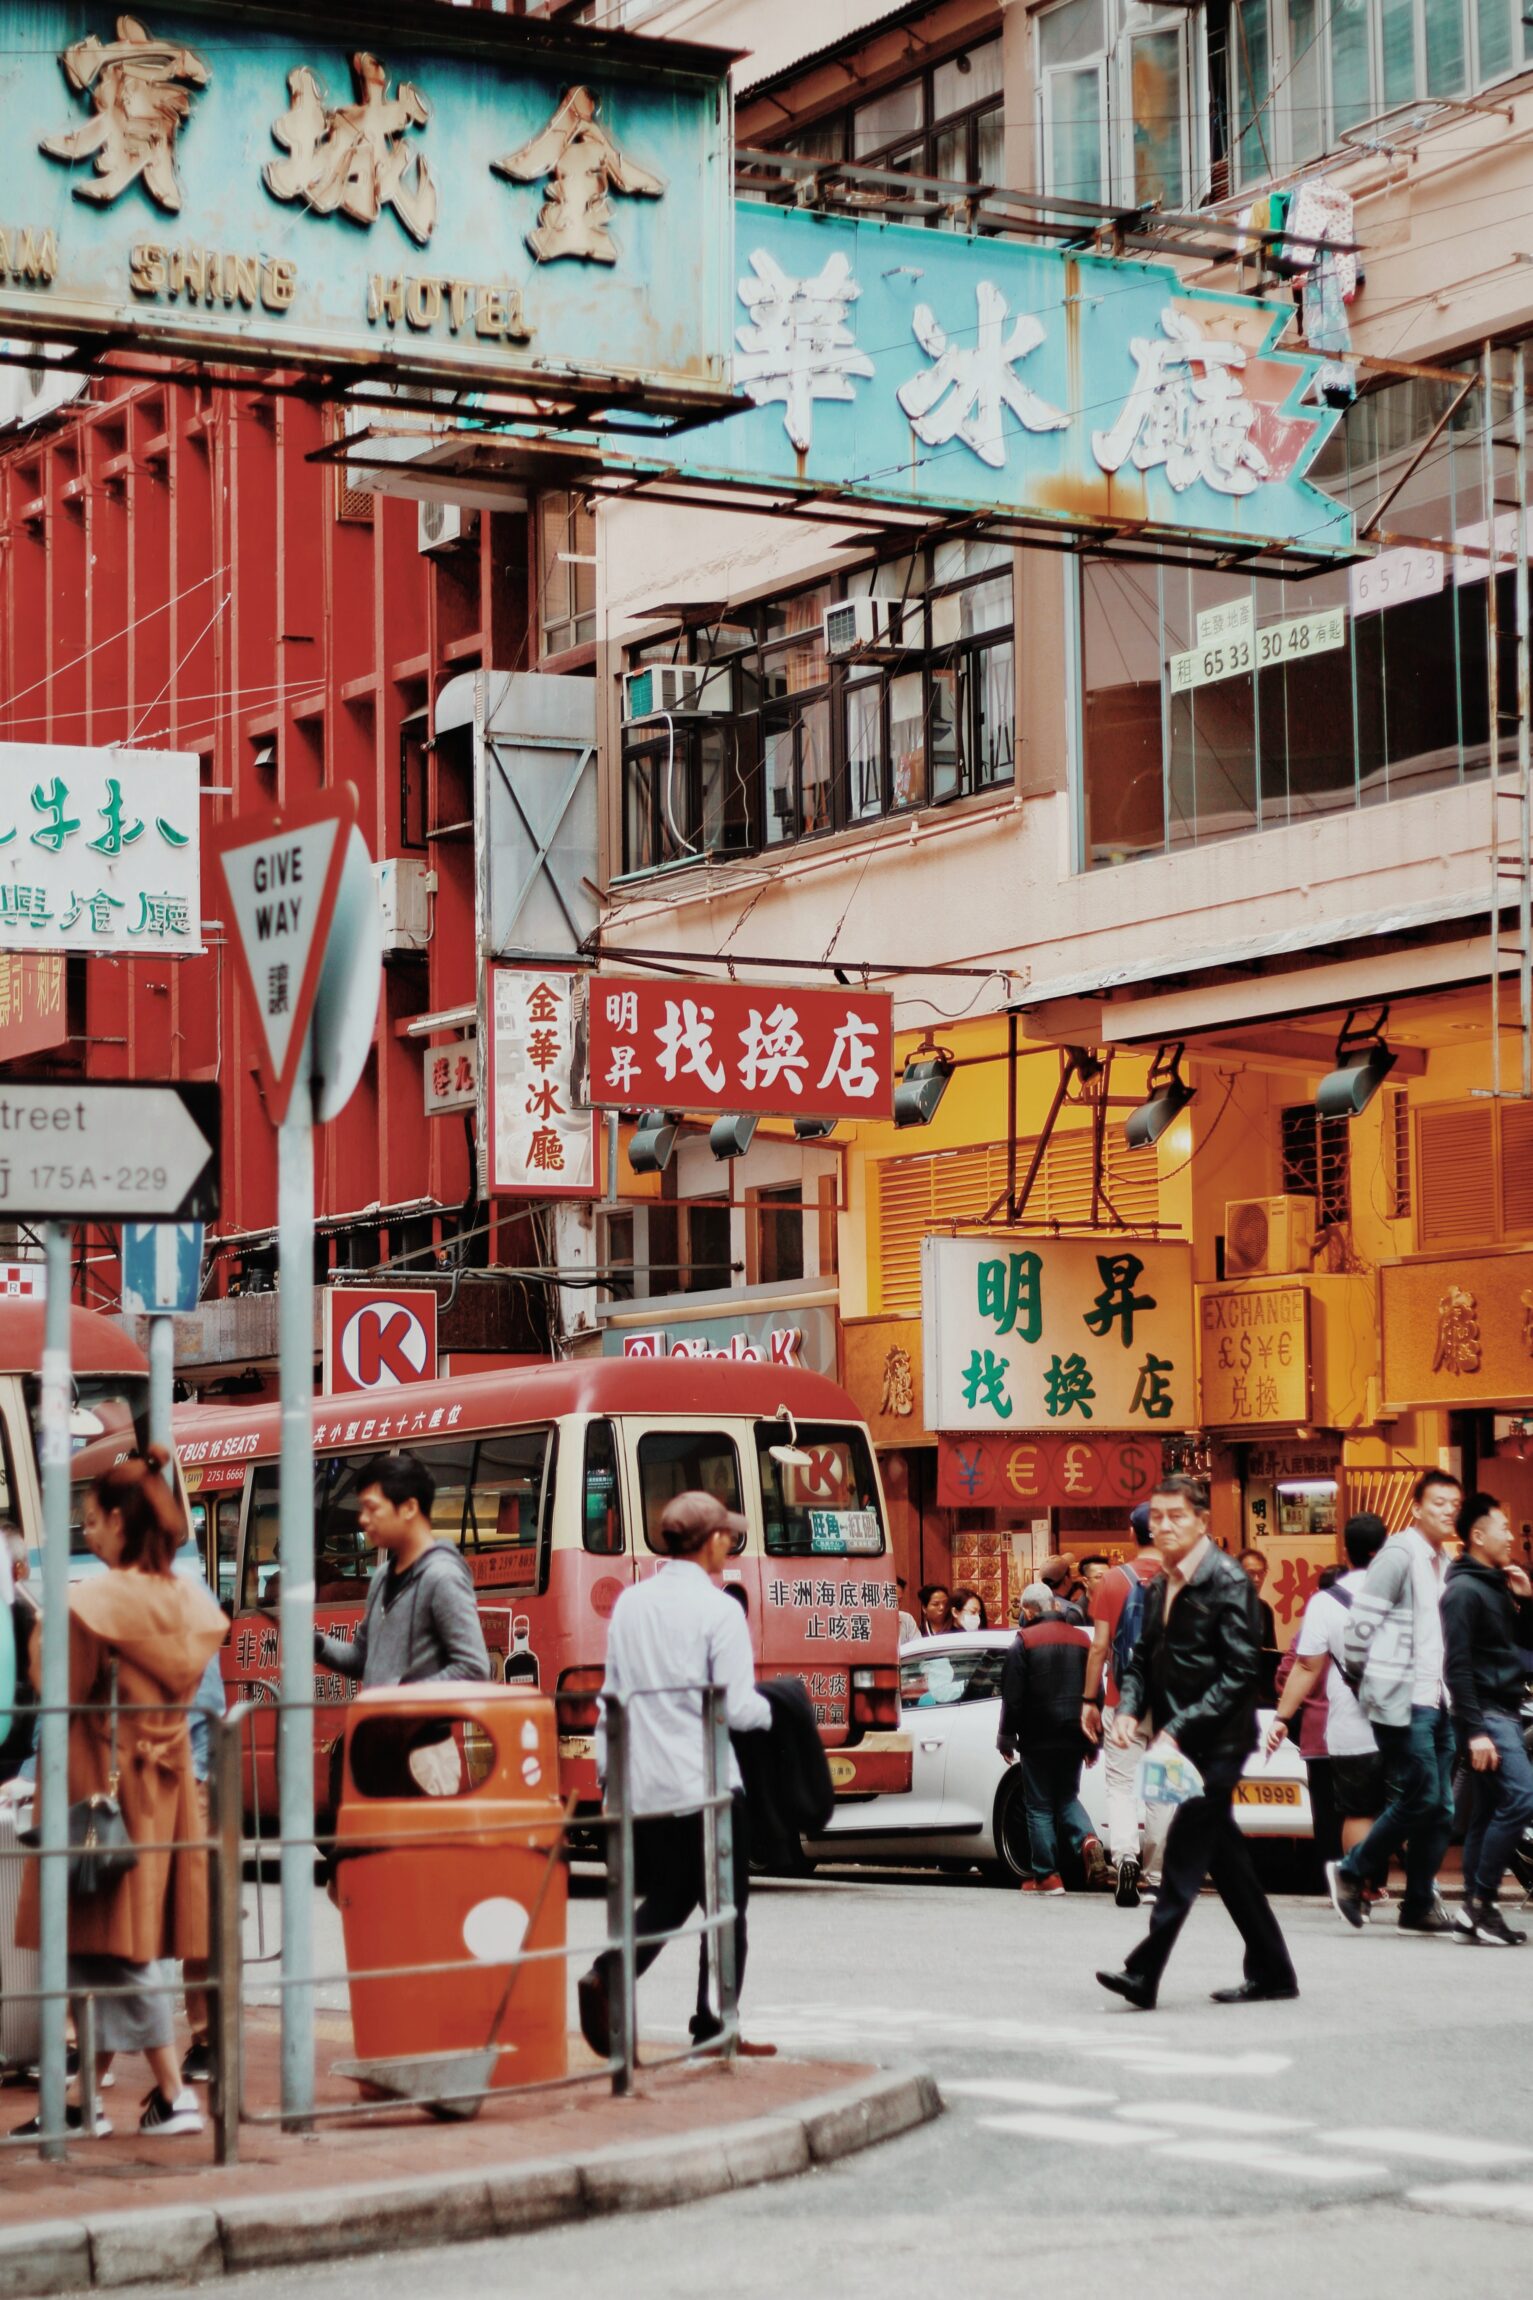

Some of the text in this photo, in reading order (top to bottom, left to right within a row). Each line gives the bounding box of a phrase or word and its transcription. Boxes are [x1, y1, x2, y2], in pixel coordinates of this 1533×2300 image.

[130, 243, 298, 313] SHING
[368, 270, 538, 344] HOTEL
[733, 247, 1270, 496] 華冰廳
[1176, 657, 1193, 686] 租
[0, 775, 191, 857] 牛扒
[253, 846, 303, 894] GIVE
[255, 896, 302, 942] WAY
[604, 991, 642, 1094] 明昇
[653, 999, 880, 1099] 找換店
[525, 981, 567, 1172] 金華冰廳
[30, 1165, 169, 1190] 175A-229
[977, 1250, 1157, 1349] 明昇
[1204, 1291, 1302, 1330] EXCHANGE
[358, 1309, 421, 1386] K
[961, 1348, 1174, 1419] 找換店
[184, 1441, 210, 1462] BUS
[209, 1439, 223, 1458] 16
[222, 1432, 260, 1457] SEATS
[206, 1470, 225, 1483] 2751
[805, 1613, 871, 1642] 止咳露
[1255, 1785, 1296, 1804] 1999
